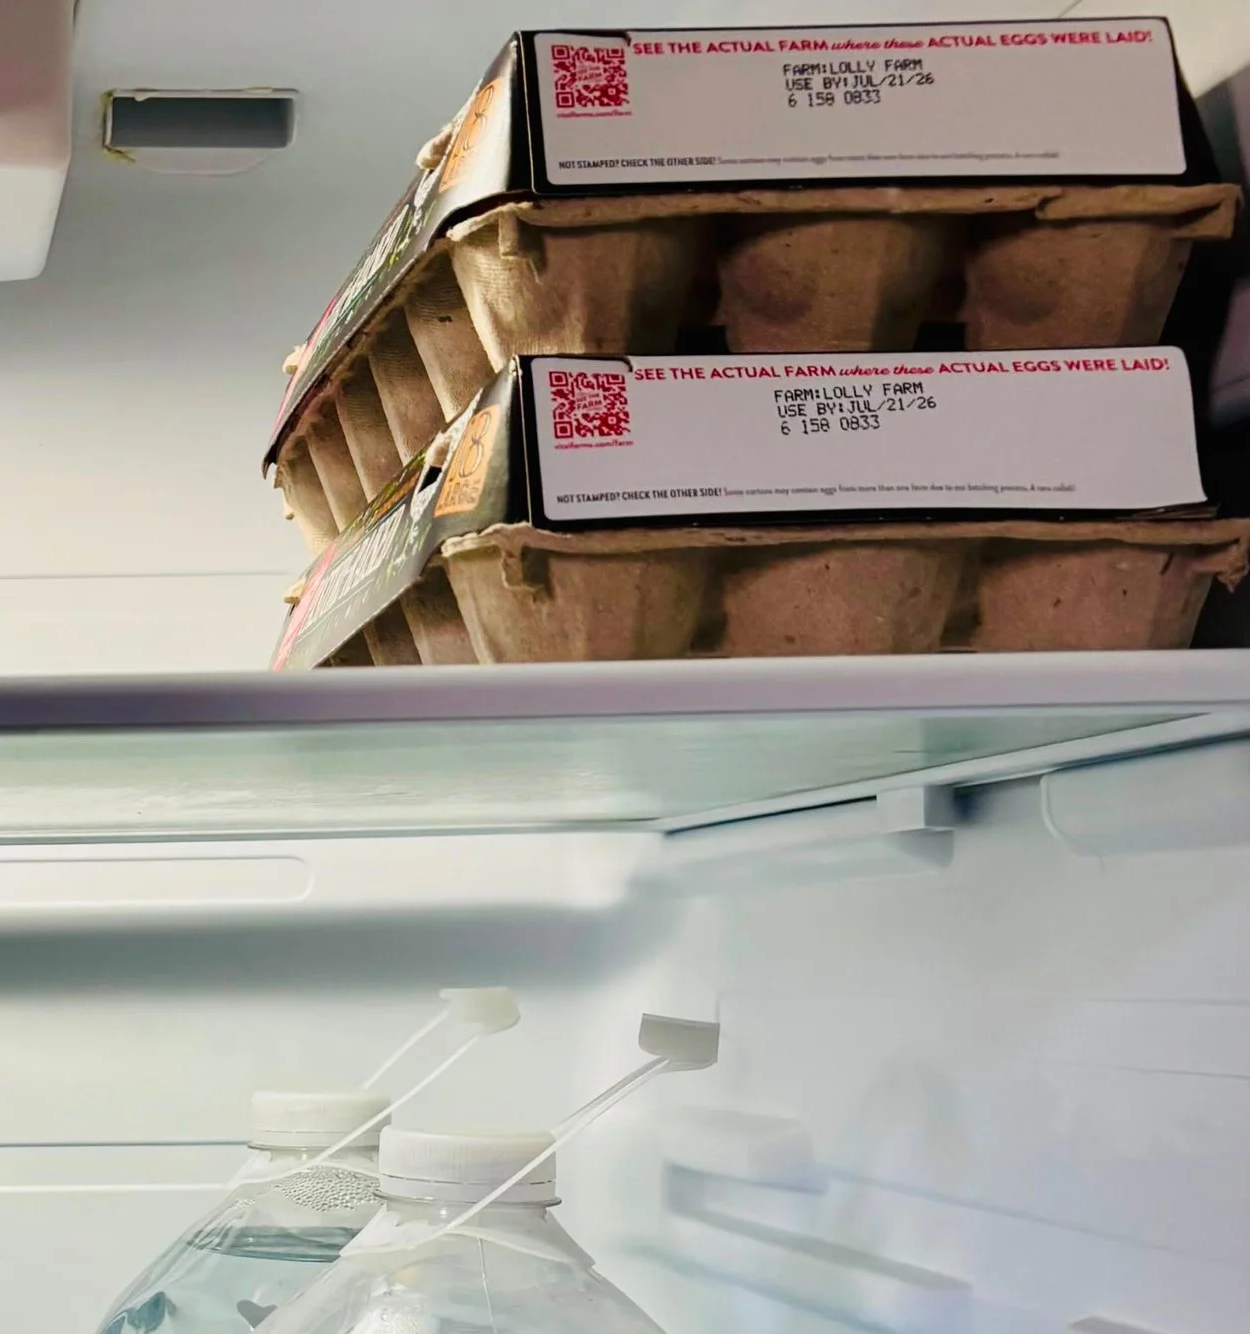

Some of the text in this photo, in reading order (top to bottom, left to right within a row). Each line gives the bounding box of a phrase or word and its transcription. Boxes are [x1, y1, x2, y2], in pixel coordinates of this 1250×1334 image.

[633, 42, 663, 55] SEE
[668, 41, 701, 54] THE
[707, 40, 773, 54] ACTUAL
[780, 39, 829, 52] FARM
[831, 38, 881, 50] where
[928, 34, 995, 48] ACTUAL
[1001, 33, 1047, 46] EGGS
[1051, 32, 1101, 44] WERE
[1106, 31, 1152, 44] LAID!
[885, 59, 923, 70] FARM
[786, 78, 813, 91] USE
[621, 159, 648, 167] CHECK
[667, 158, 694, 166] OTHER
[634, 368, 665, 381] SEE
[671, 367, 705, 379] THE
[710, 367, 780, 379] ACTUAL
[785, 365, 836, 377] FARM
[839, 364, 890, 377] where
[939, 361, 1009, 373] ACTUAL
[1013, 360, 1061, 372] EGGS
[1065, 359, 1117, 371] WERE
[1122, 358, 1169, 370] LAID!
[774, 382, 924, 402] FARM:LOLLY FARM
[778, 404, 806, 417] USE
[781, 422, 790, 435] 6
[558, 495, 574, 503] NOT
[577, 493, 620, 502] STAMPED?
[622, 491, 650, 500] CHECK
[653, 491, 668, 499] THE
[670, 489, 698, 498] OTHER
[700, 488, 722, 497] SIDE!
